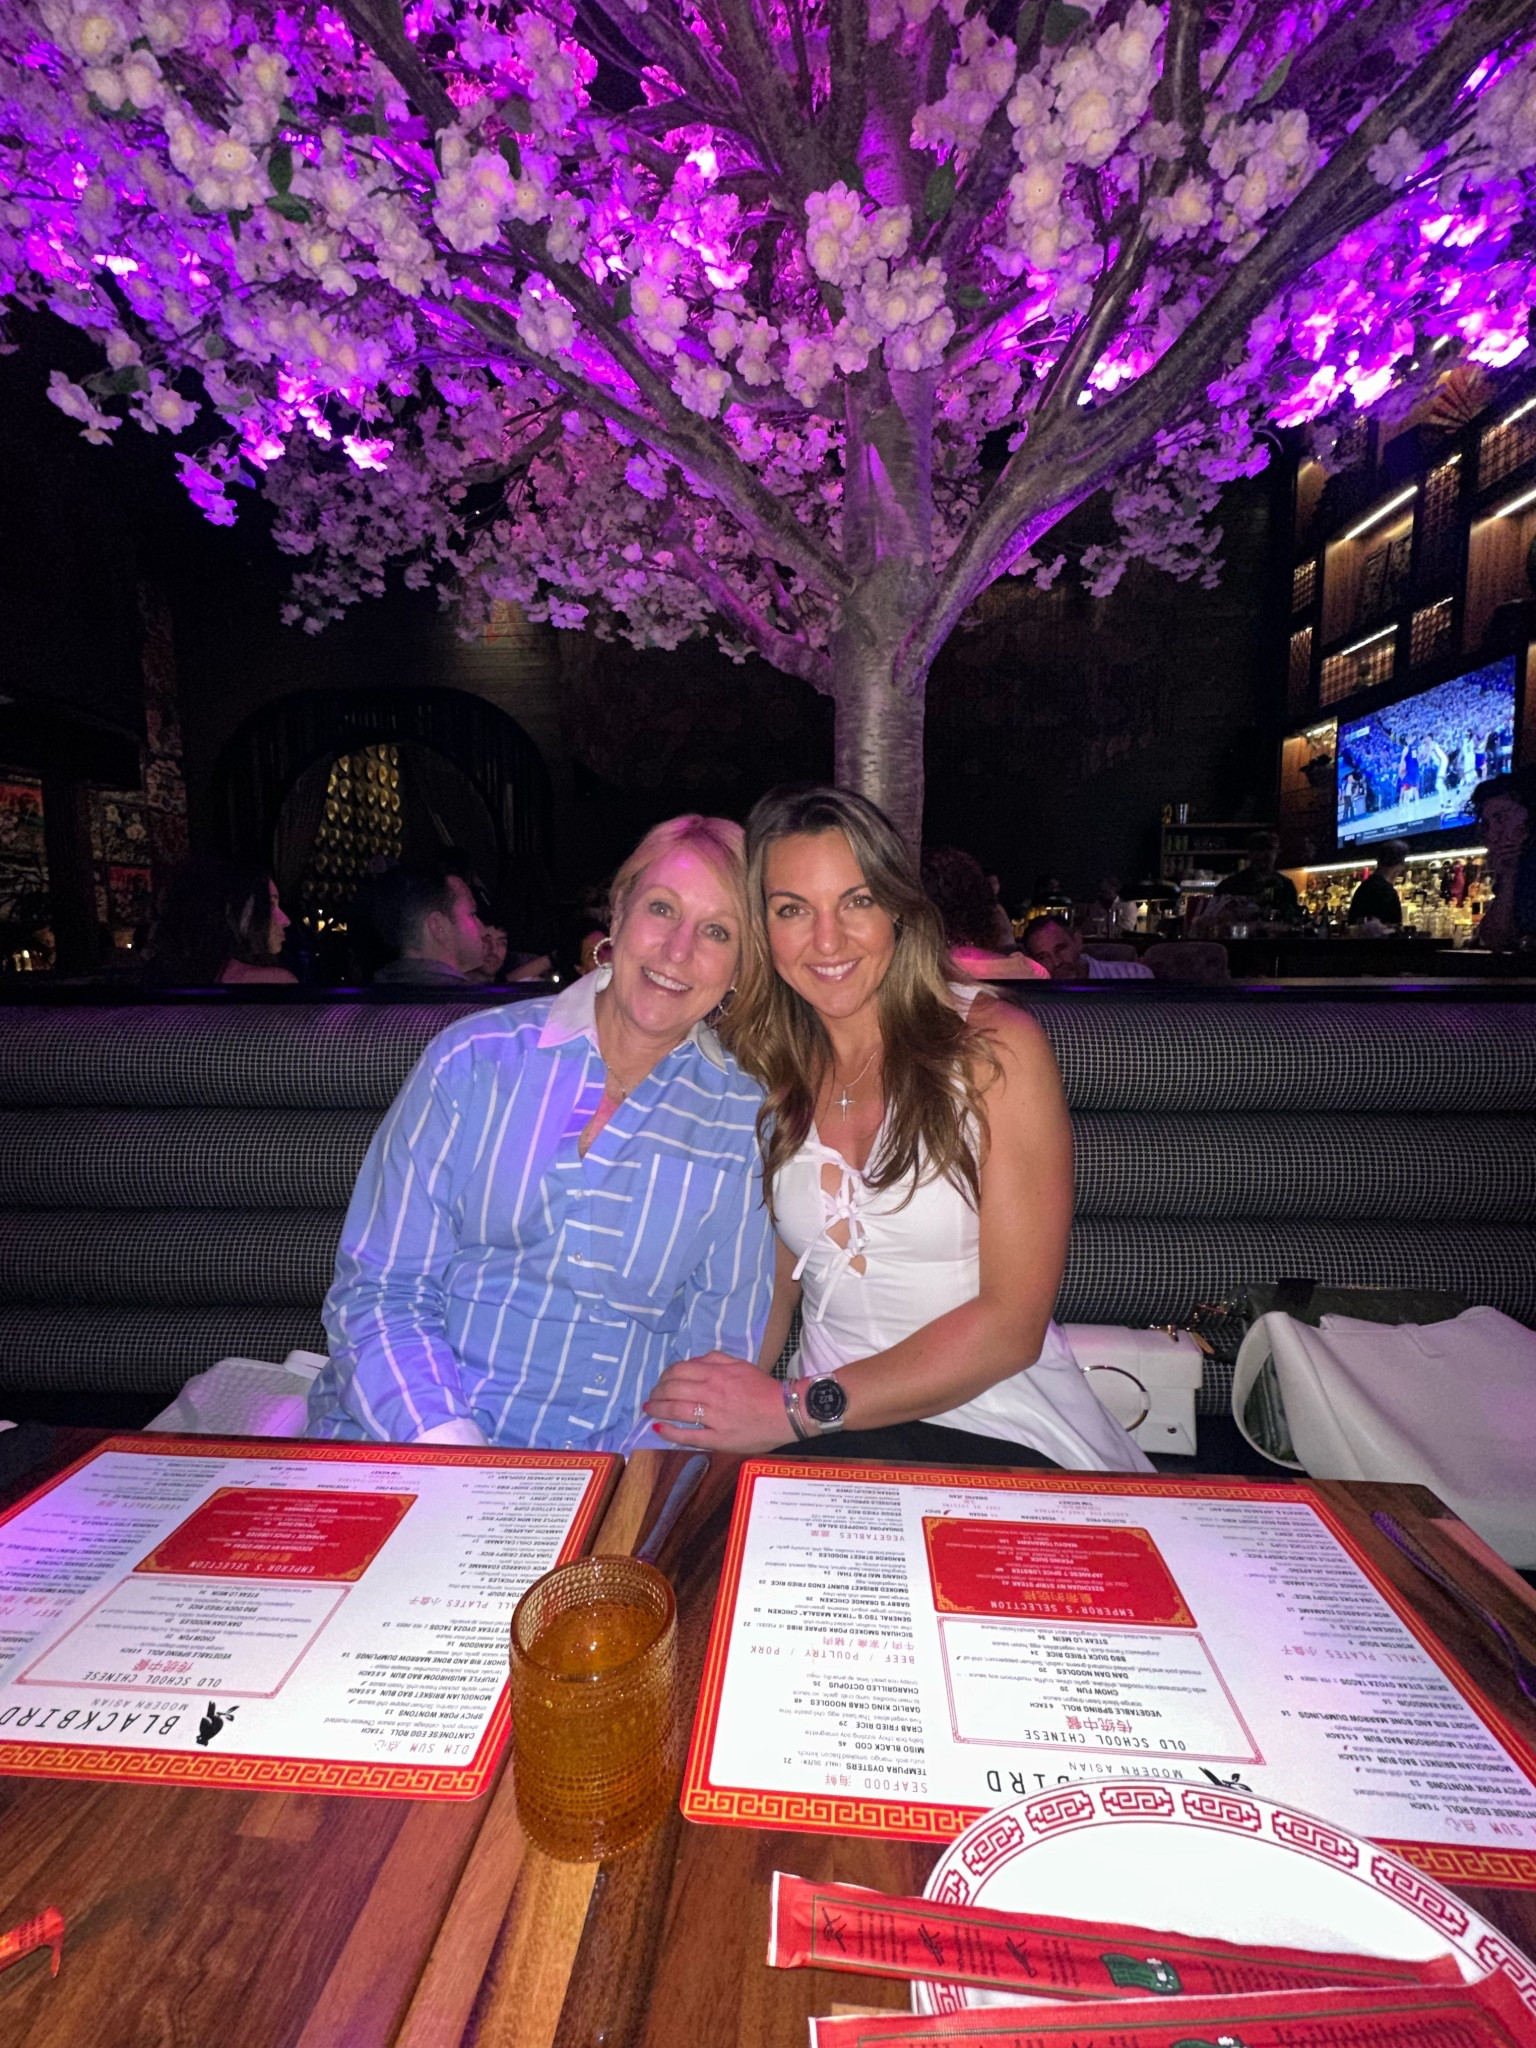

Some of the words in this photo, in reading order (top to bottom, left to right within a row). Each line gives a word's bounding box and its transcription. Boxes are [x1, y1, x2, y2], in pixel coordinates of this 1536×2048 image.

[839, 1530, 905, 1542] VEGETABLES
[851, 1584, 879, 1592] BRISKET
[445, 1598, 490, 1610] PLATES
[819, 1596, 850, 1604] CHICKEN
[851, 1598, 879, 1606] ORANGE
[989, 1600, 1058, 1613] SELECTION
[1065, 1604, 1135, 1617] EMPEROR'S
[767, 1607, 798, 1616] CHICKEN
[880, 1614, 912, 1622] GENERAL
[829, 1626, 848, 1634] PORK
[849, 1627, 880, 1636] SMOKED
[880, 1629, 913, 1638] SICHUAN
[1052, 1635, 1073, 1643] MEIN
[1072, 1636, 1084, 1644] LO
[1083, 1637, 1109, 1645] STEAK
[458, 1641, 495, 1649] RANGOON
[750, 1646, 780, 1656] PORK
[805, 1649, 859, 1661] POULTRY
[1045, 1650, 1064, 1658] RICE
[1064, 1651, 1087, 1660] FRIED
[355, 1652, 399, 1661] DUMPLINGS
[398, 1654, 433, 1662] MARROW
[885, 1654, 915, 1664] BEEF
[1087, 1653, 1110, 1661] DUCK
[1109, 1654, 1127, 1662] BBQ
[482, 1658, 509, 1666] SHORT
[358, 1669, 376, 1677] EACH
[423, 1672, 468, 1681] MUSHROOM
[1055, 1667, 1094, 1677] NOODLES
[1093, 1670, 1112, 1678] DAN
[1111, 1671, 1129, 1679] DAN
[82, 1672, 140, 1683] CHINESE
[144, 1675, 193, 1686] SCHOOL
[196, 1677, 224, 1687] OLD
[468, 1675, 500, 1683] TRUFFLE
[828, 1681, 865, 1691] OCTOPUS
[866, 1684, 919, 1694] CHARGRILLED
[1075, 1686, 1093, 1694] FUN
[347, 1687, 366, 1695] EACH
[379, 1688, 398, 1696] BUN
[396, 1689, 415, 1697] BAO
[413, 1690, 447, 1699] BRISKET
[1093, 1687, 1119, 1696] CHOW
[446, 1692, 493, 1701] MONGOLIAN
[90, 1698, 133, 1708] ASIAN
[134, 1700, 190, 1711] MODERN
[810, 1698, 847, 1708] NOODLES
[848, 1701, 870, 1709] CRAB
[871, 1702, 891, 1711] KING
[1028, 1701, 1049, 1710] EACH
[1060, 1703, 1084, 1712] ROLL
[892, 1704, 921, 1713] GARLIC
[1082, 1705, 1114, 1714] SPRING
[1114, 1707, 1162, 1717] VEGETABLE
[398, 1709, 439, 1718] WONTONS
[438, 1711, 460, 1719] PORK
[460, 1712, 484, 1720] SPICY
[0, 1707, 181, 1735] BLACKBIRD
[856, 1721, 874, 1729] RICE
[360, 1727, 380, 1735] EACH
[875, 1722, 899, 1731] FRIED
[901, 1724, 923, 1733] CRAB
[390, 1728, 411, 1736] ROLL
[409, 1729, 428, 1737] EGG
[428, 1730, 476, 1740] CANTONESE
[1022, 1729, 1087, 1744] CHINESE
[855, 1741, 873, 1750] COD
[1094, 1734, 1150, 1748] SCHOOL
[1158, 1738, 1187, 1751] OLD
[409, 1741, 436, 1753] SUM
[443, 1743, 471, 1755] DIM
[875, 1742, 901, 1752] BLACK
[903, 1745, 925, 1754] MISO
[846, 1762, 884, 1772] OYSTERS
[886, 1765, 927, 1776] TEMPURA
[1068, 1761, 1114, 1774] ASIAN
[1120, 1765, 1183, 1778] MODERN
[864, 1777, 928, 1794] SEAFOOD
